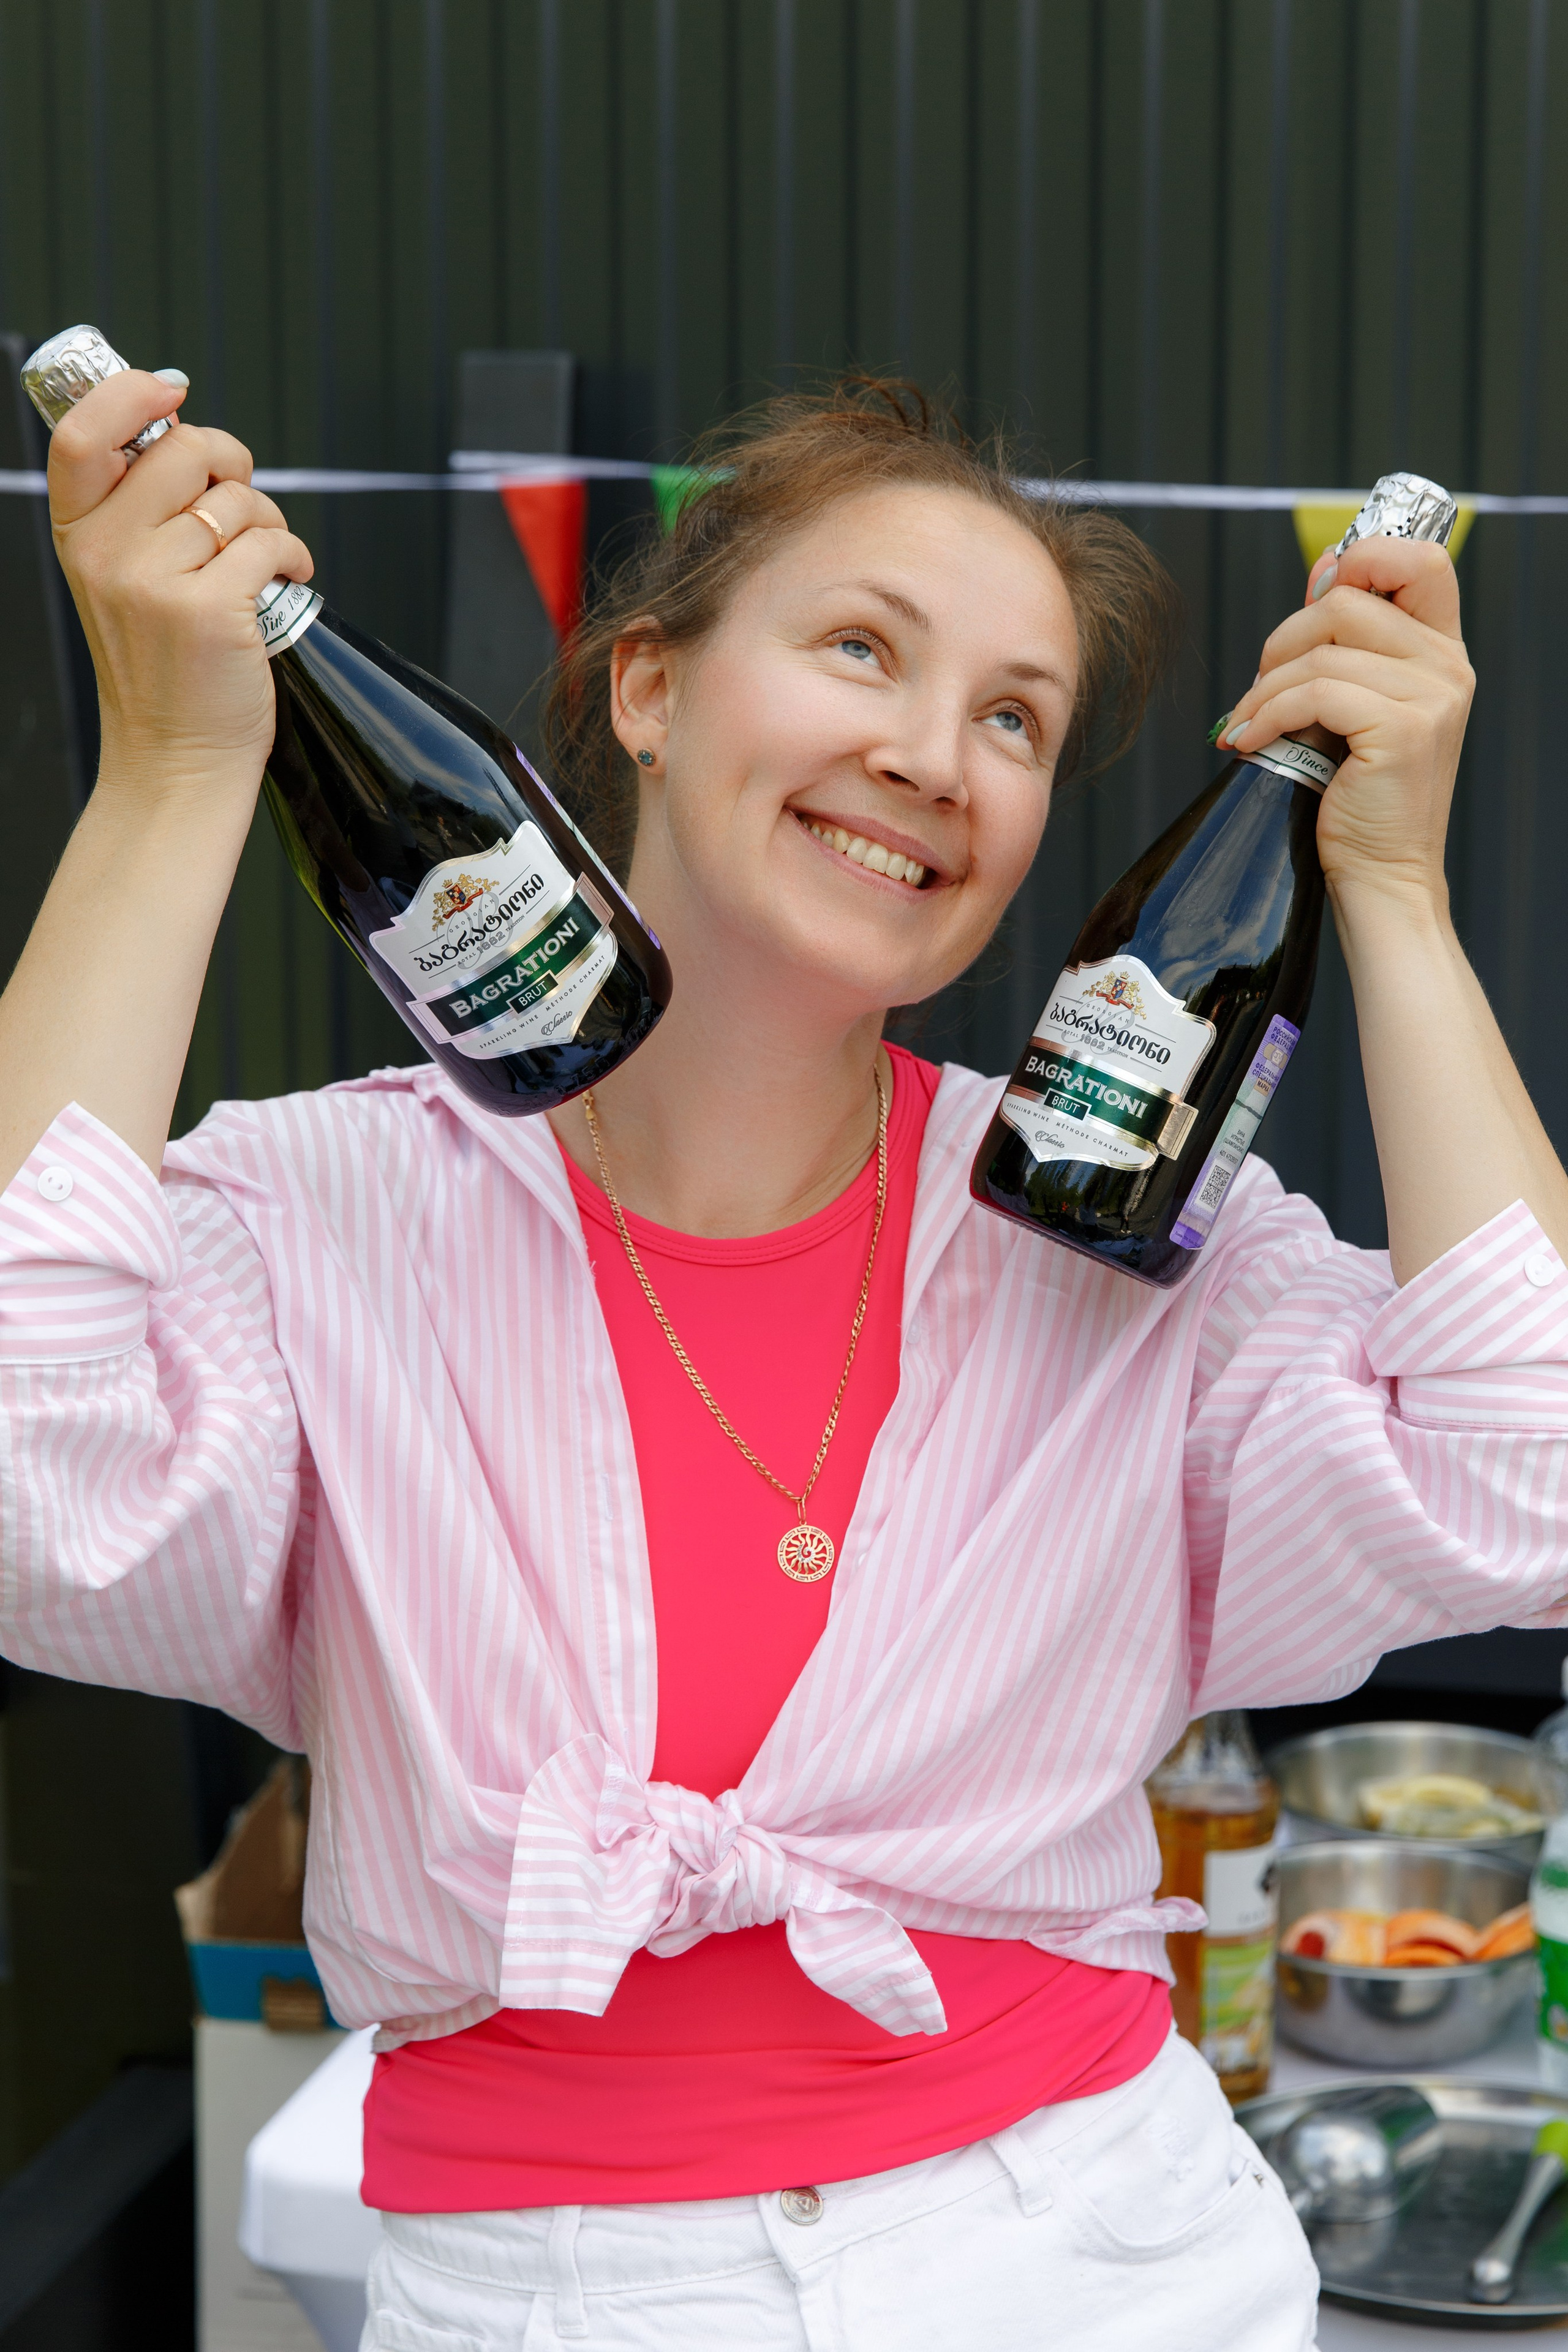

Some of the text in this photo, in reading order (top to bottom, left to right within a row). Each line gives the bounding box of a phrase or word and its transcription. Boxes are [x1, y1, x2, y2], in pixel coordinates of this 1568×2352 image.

[287, 586, 305, 611] 1882
[1283, 747, 1329, 775] Since
[413, 873, 545, 972] ბაგრატიონი
[449, 899, 495, 933] GEORGIAN
[458, 914, 525, 965] ROYAL 1882 TRADITION
[450, 916, 581, 1018] BAGRATIONI
[480, 1028, 517, 1049] SPARKLING
[519, 1014, 539, 1028] WINE
[579, 955, 605, 983] CHARMAT
[518, 981, 548, 1007] BRUT
[541, 1010, 573, 1036] Classic
[1086, 1003, 1130, 1024] GEORGIAN
[1050, 1002, 1171, 1065] ბაგრატიონი
[1063, 1029, 1129, 1058] ROYAL 1882 TRADITION
[1025, 1055, 1149, 1120] BAGRATIONI
[1257, 1080, 1270, 1092] МАРКА
[1051, 1095, 1080, 1114] BRUT
[1007, 1102, 1031, 1115] SPARKLING
[1033, 1112, 1049, 1122] WINE
[1093, 1138, 1129, 1157] CHARMAT
[1035, 1130, 1066, 1149] Classic
